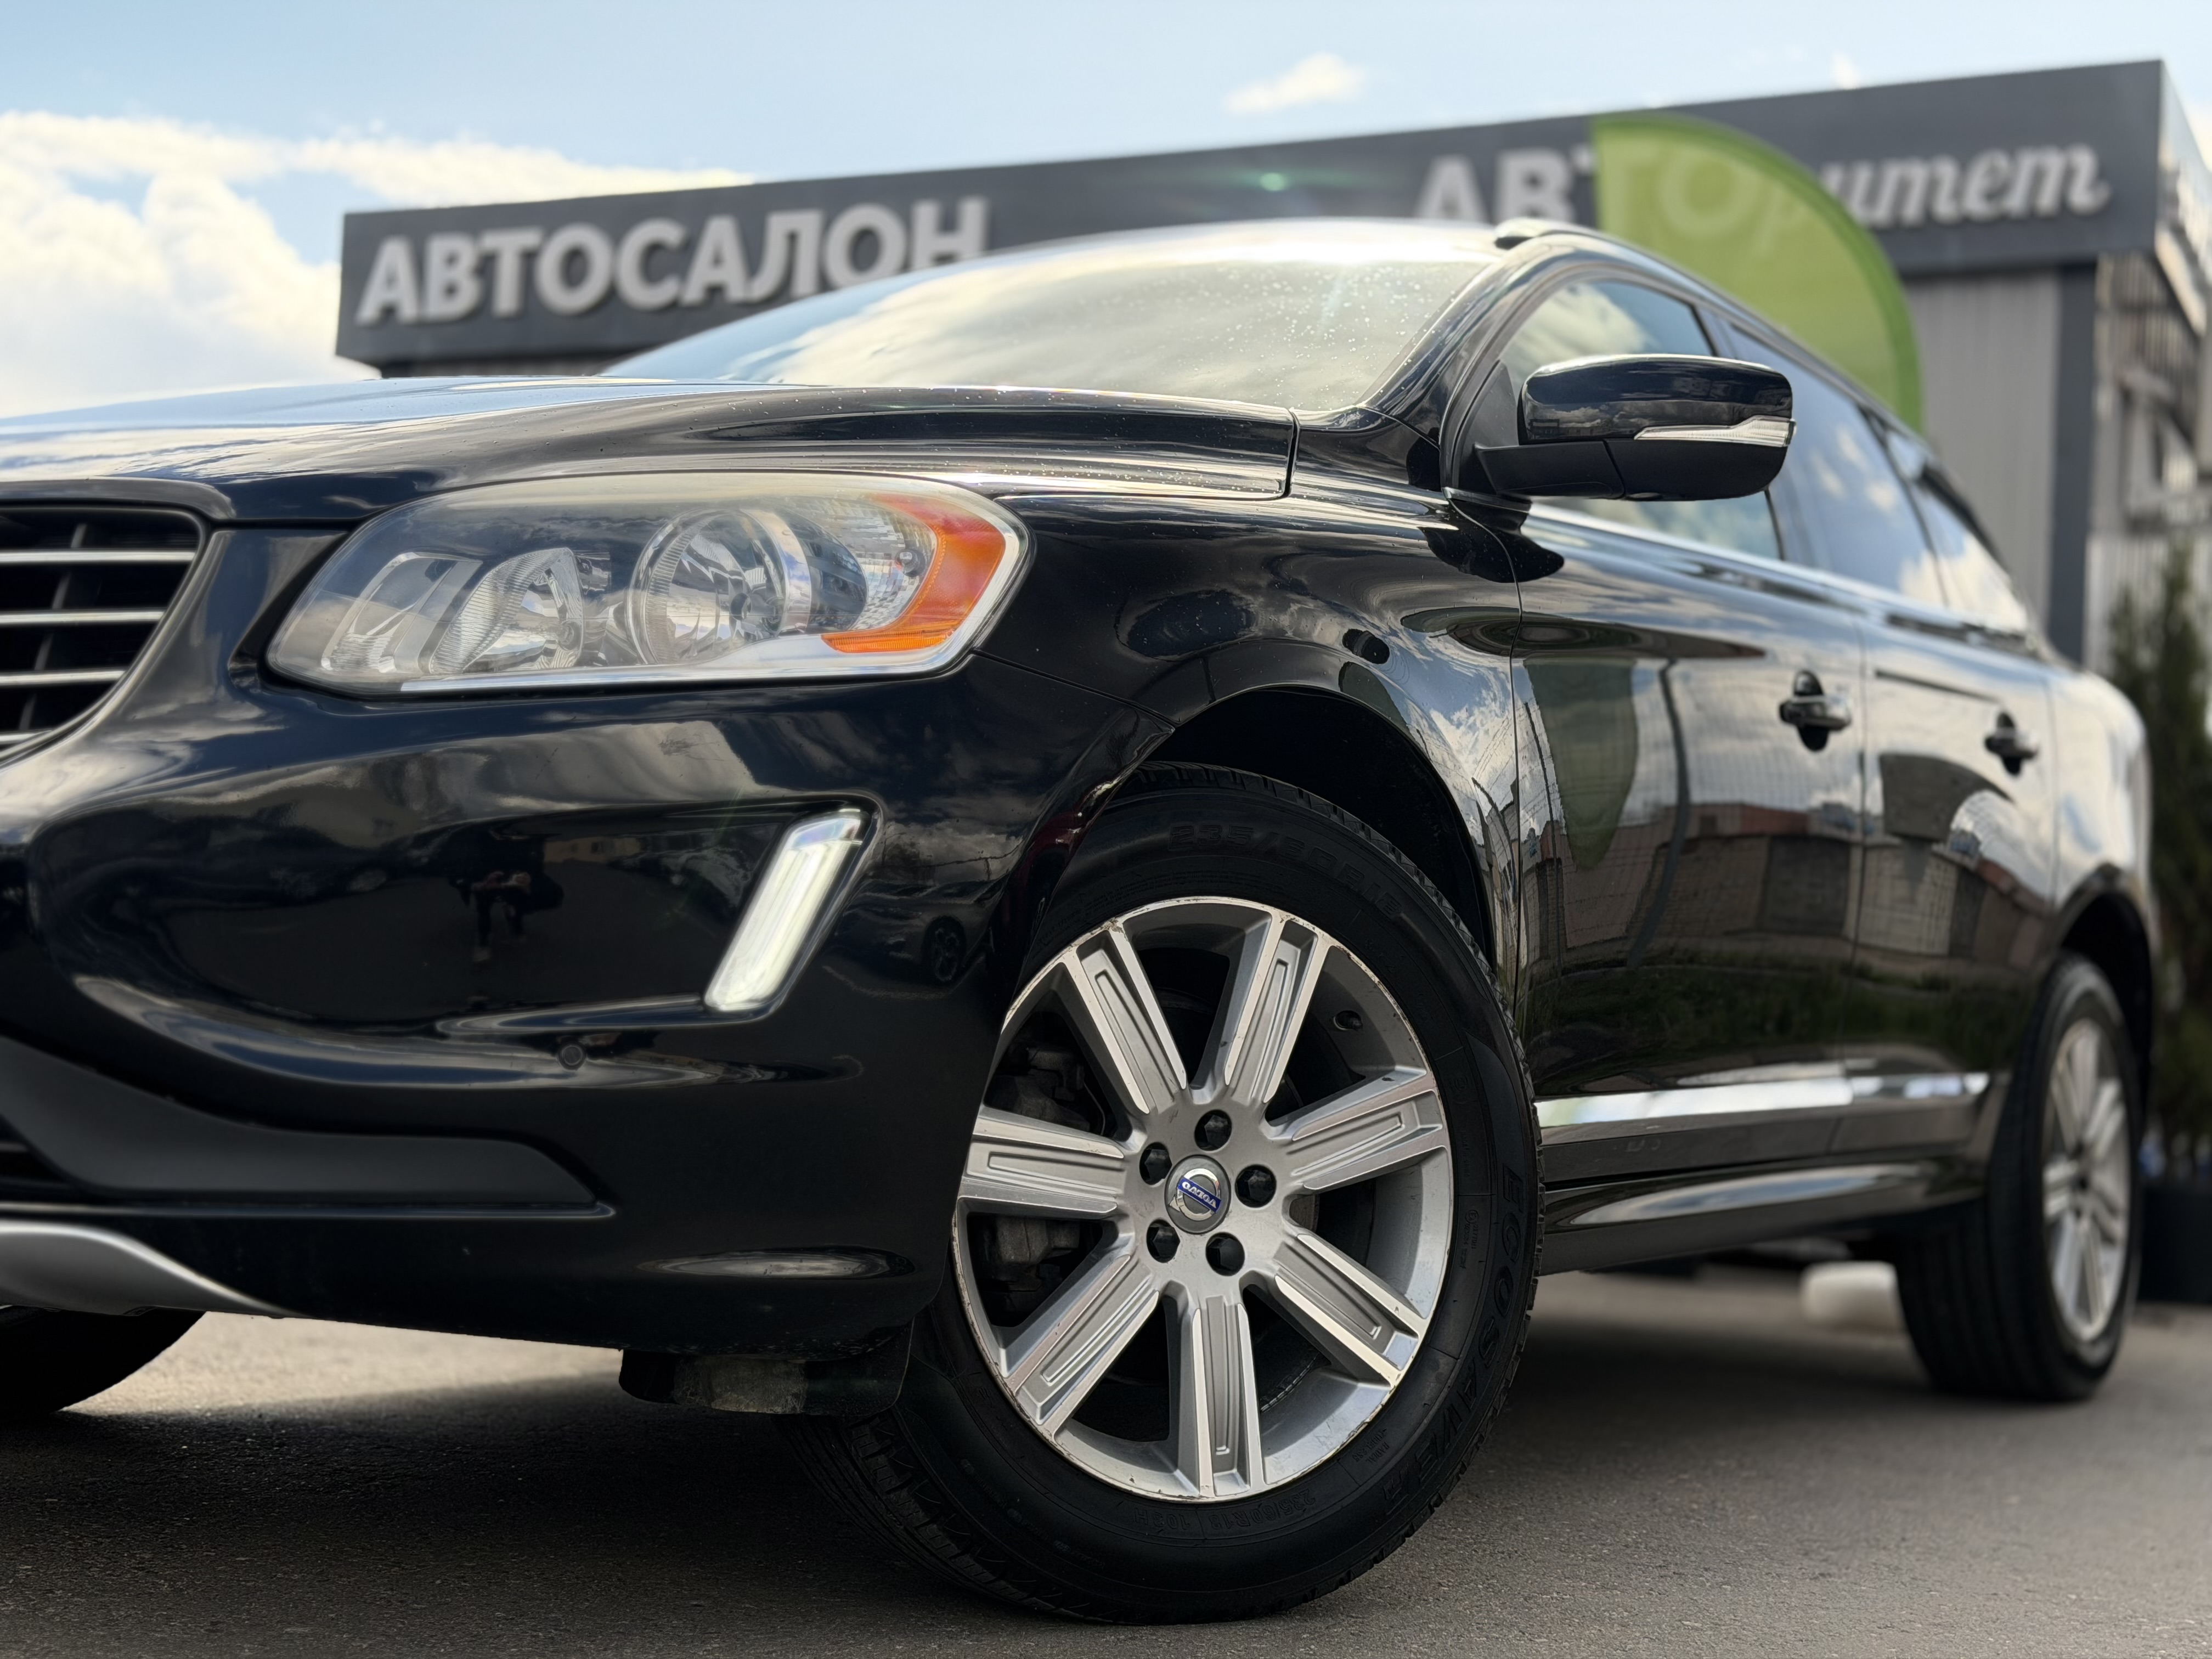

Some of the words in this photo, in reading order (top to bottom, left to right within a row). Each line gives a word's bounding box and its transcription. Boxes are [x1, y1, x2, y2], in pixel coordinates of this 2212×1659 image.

[354, 197, 988, 326] АВТОСАЛОН
[1182, 1181, 1217, 1209] VOLVO
[1134, 1506, 1190, 1531] 103H
